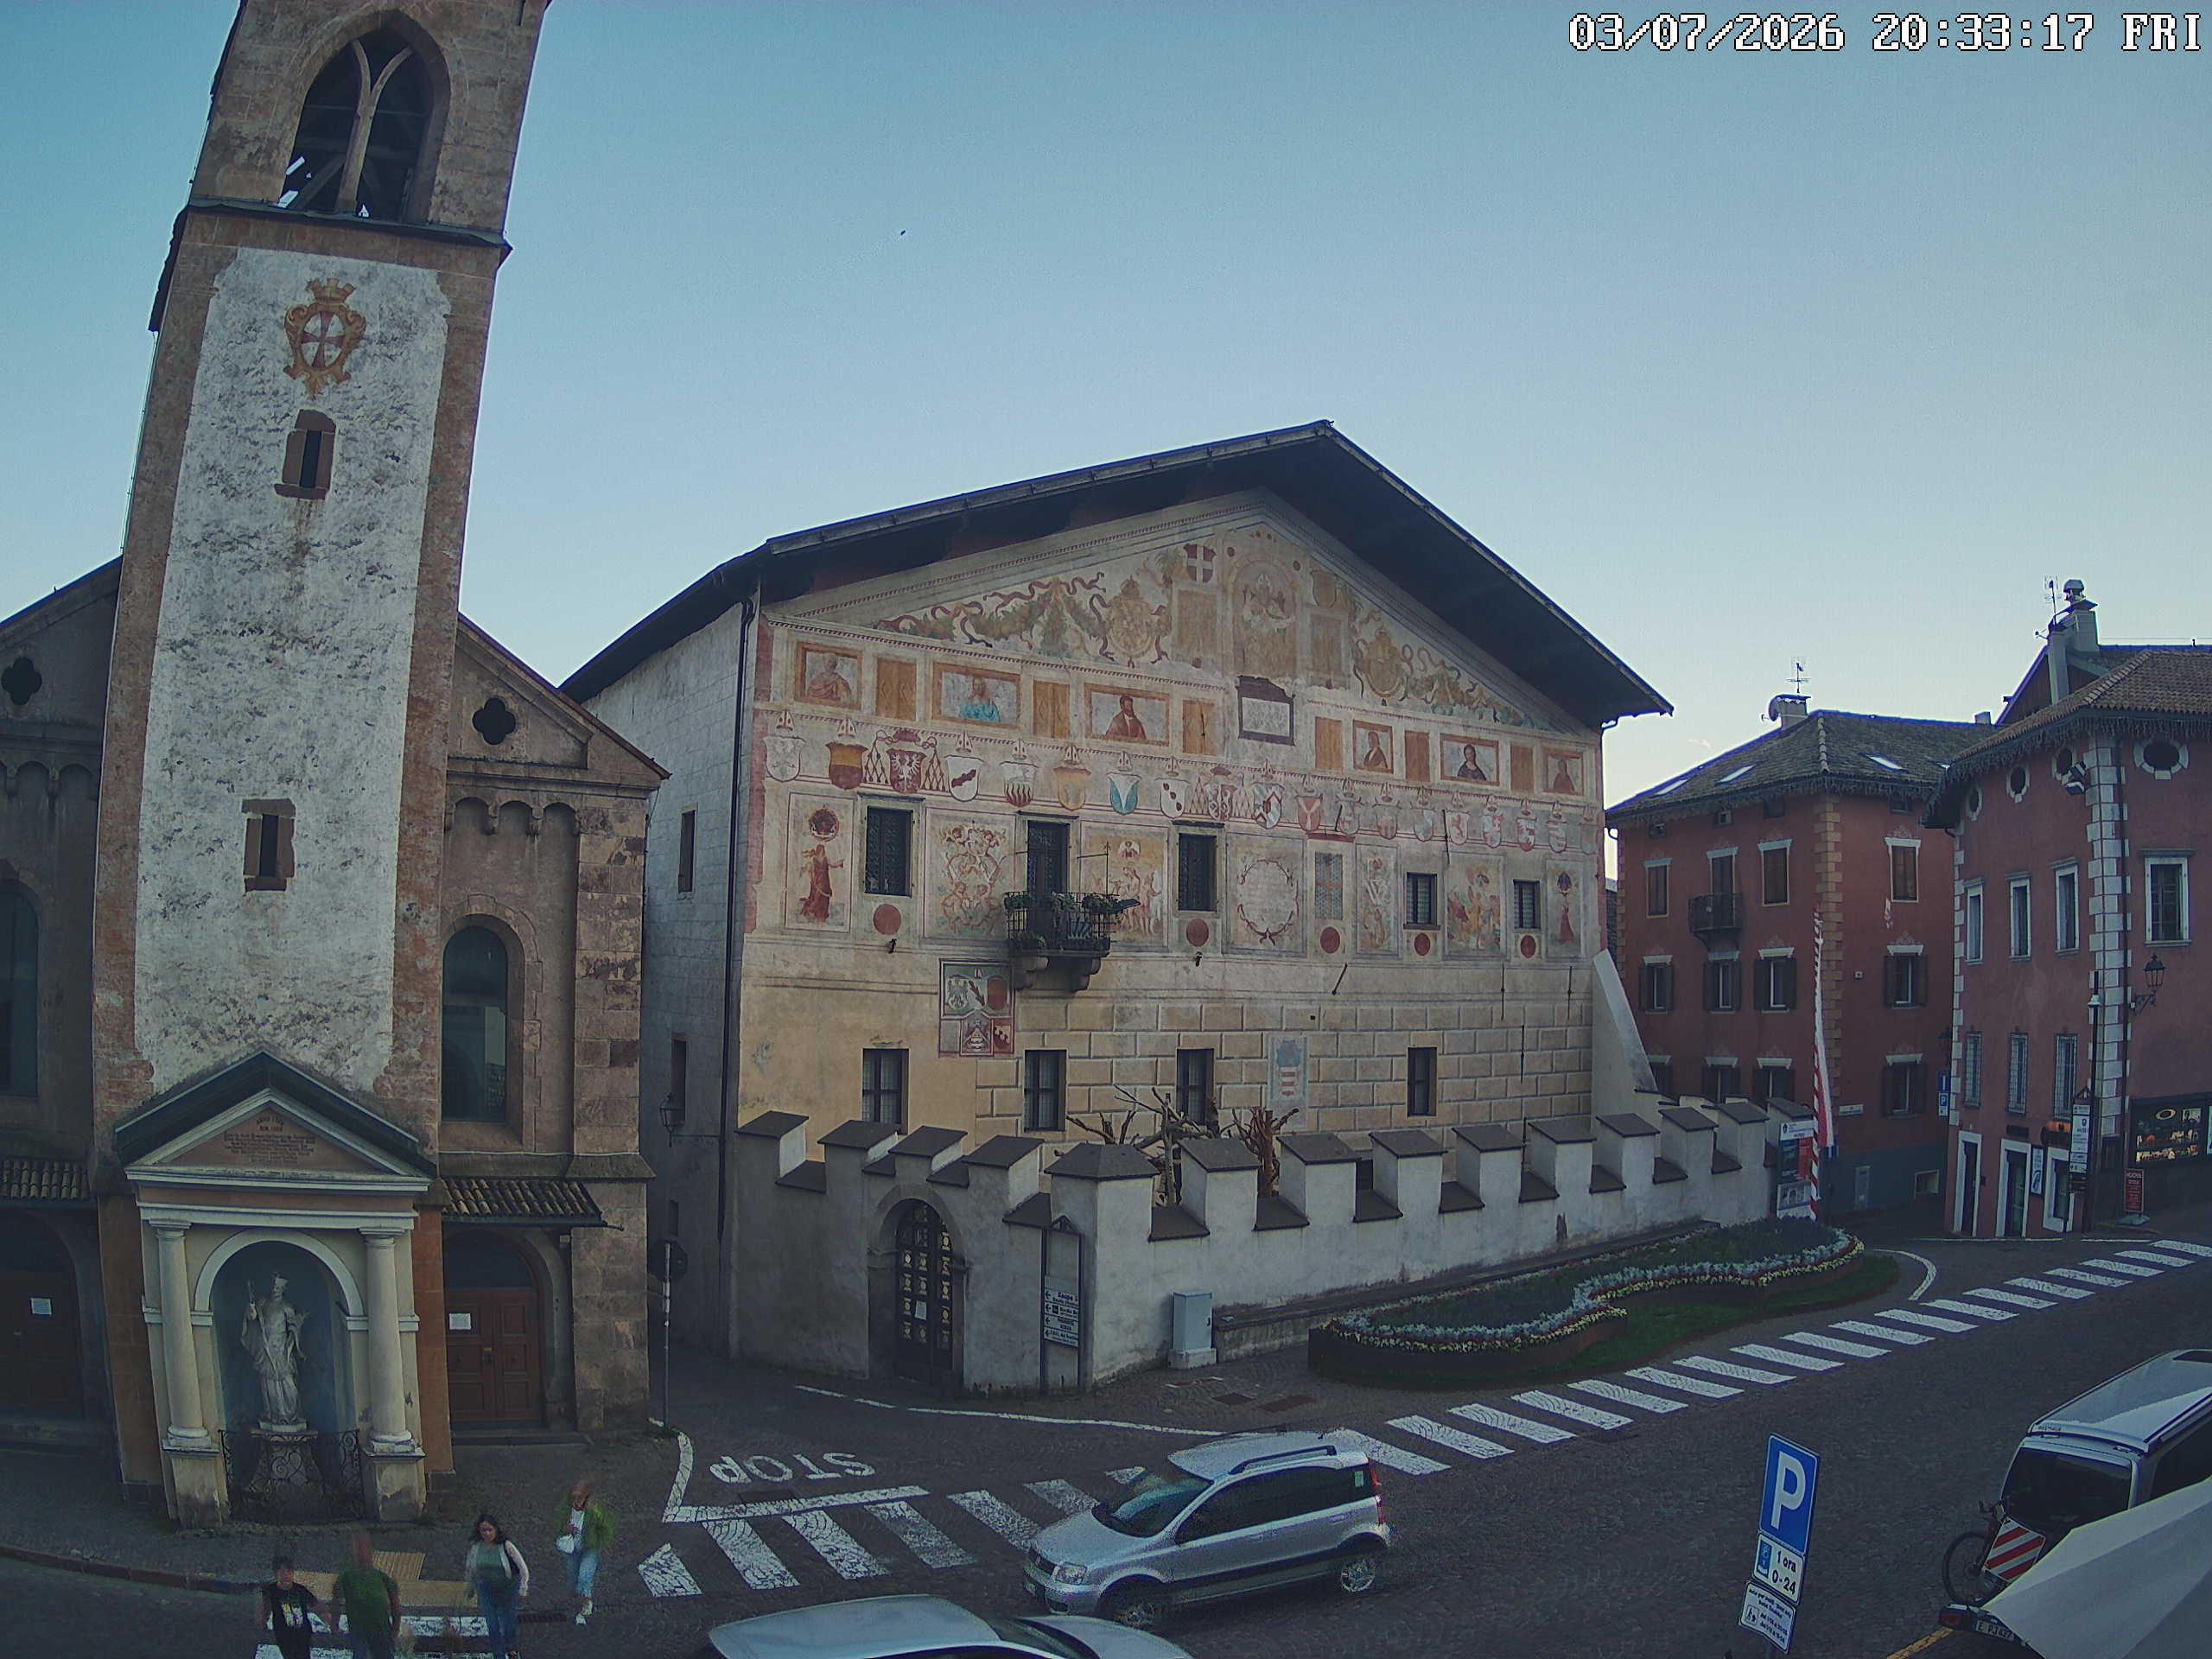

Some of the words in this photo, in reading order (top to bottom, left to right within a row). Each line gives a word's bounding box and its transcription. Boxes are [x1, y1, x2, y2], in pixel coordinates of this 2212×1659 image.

[709, 1452, 876, 1484] STOP
[1770, 1450, 1806, 1529] P
[1783, 1557, 1796, 1573] ora
